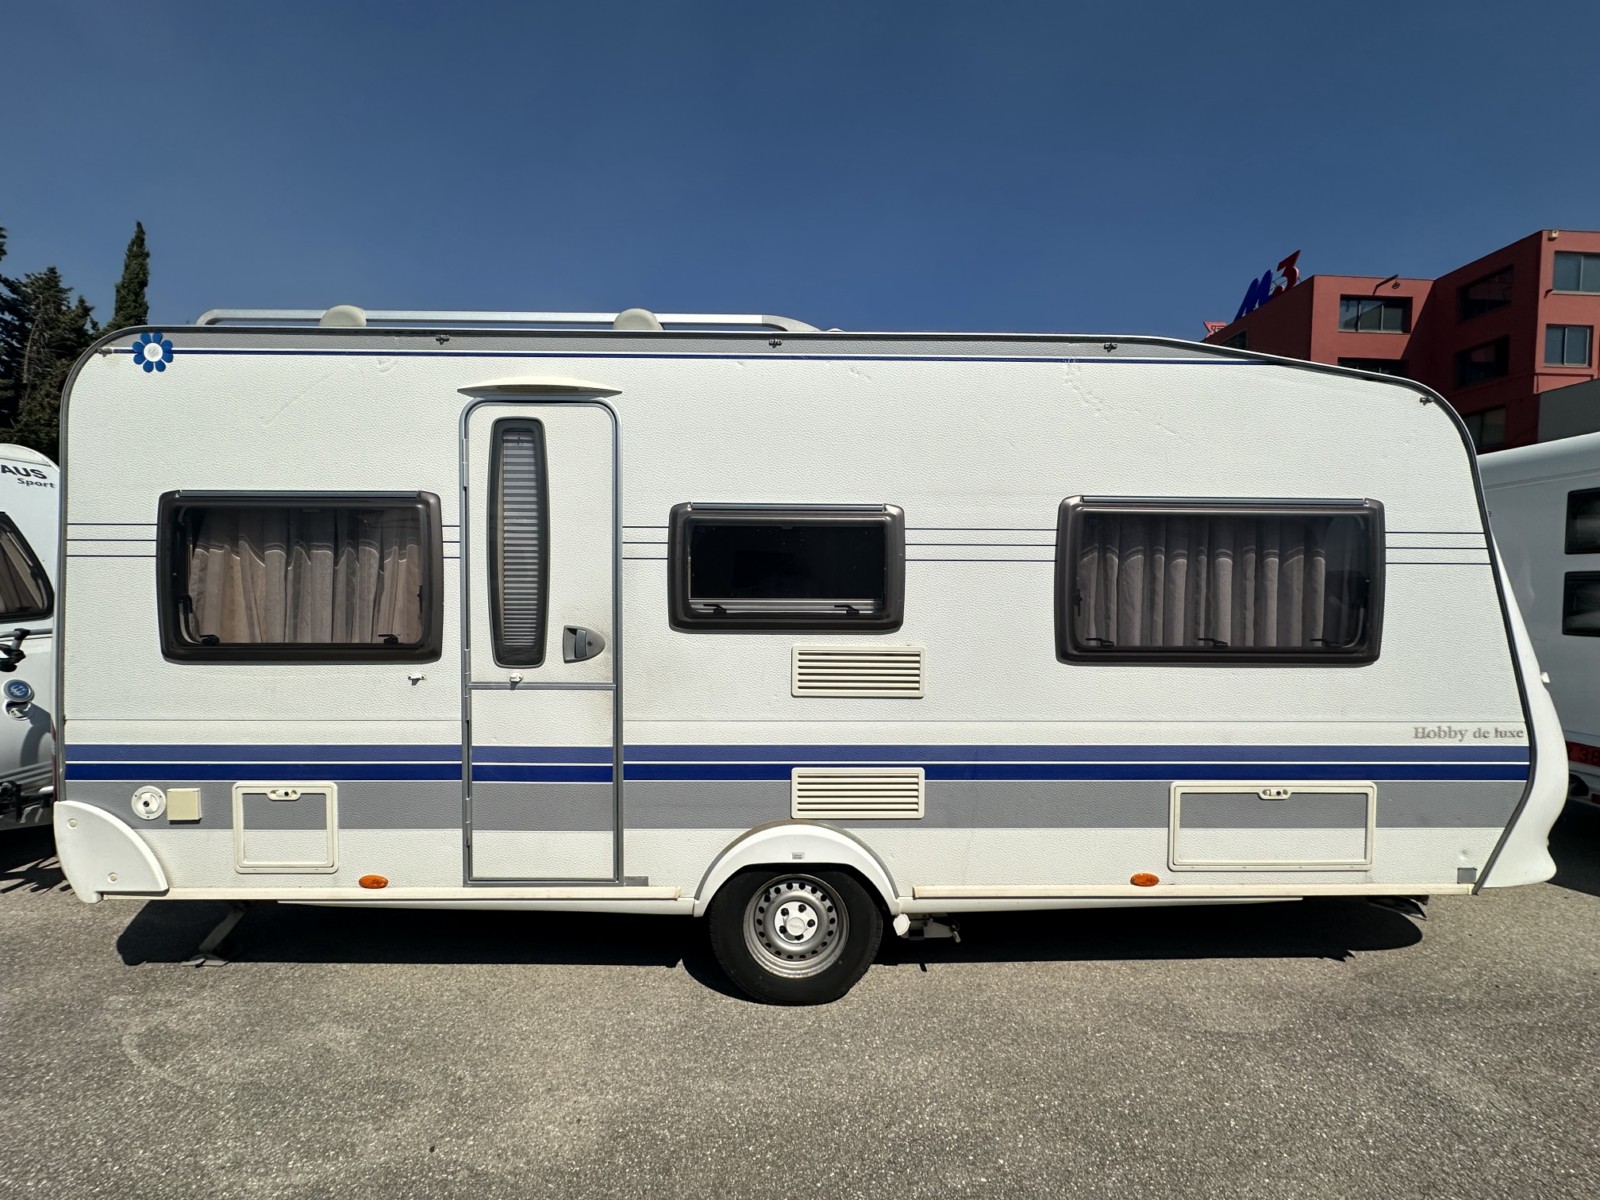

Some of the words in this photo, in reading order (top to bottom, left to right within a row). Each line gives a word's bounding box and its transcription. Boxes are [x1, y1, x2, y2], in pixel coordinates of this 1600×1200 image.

[17, 477, 56, 489] Sport
[1412, 725, 1469, 742] Hobby
[1472, 727, 1491, 739] de
[1493, 726, 1525, 739] luxe
